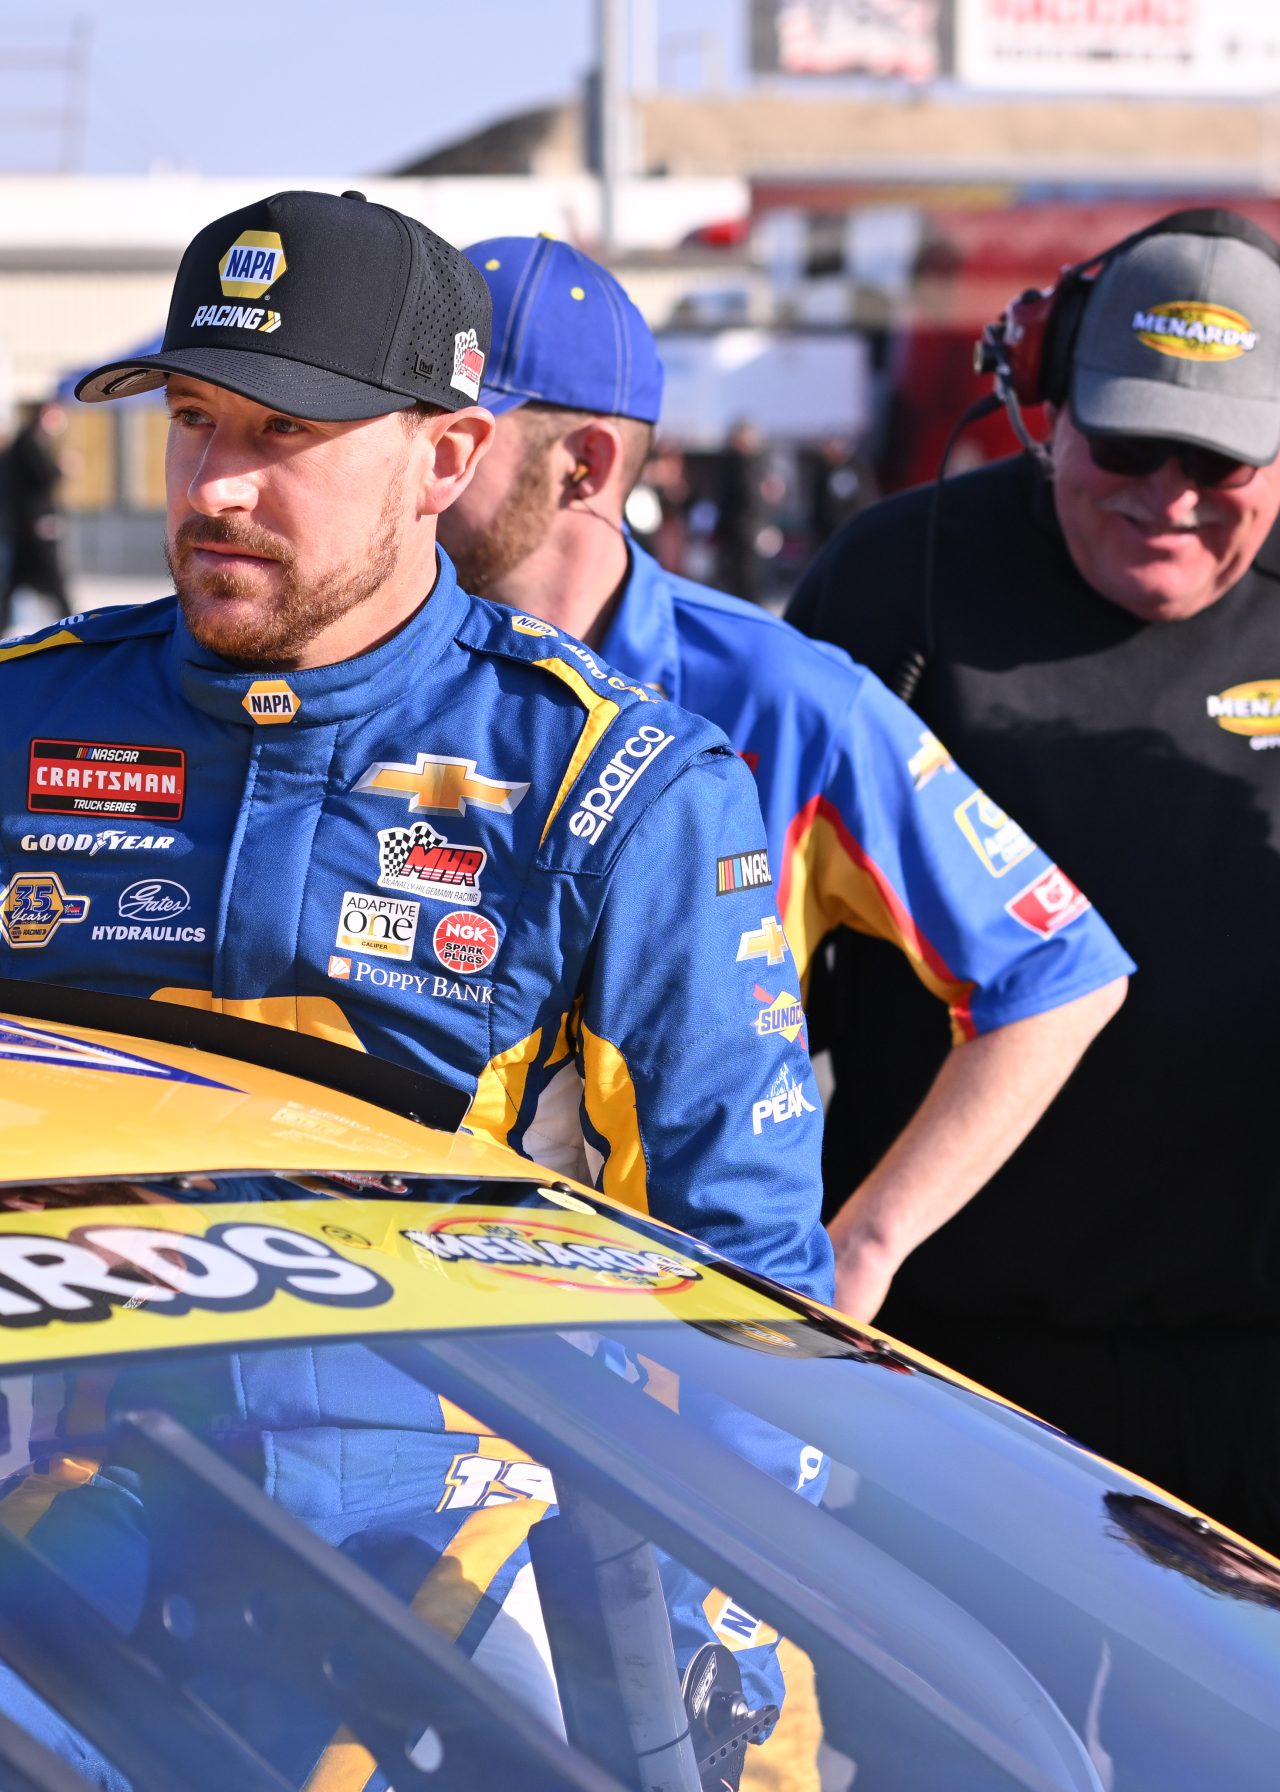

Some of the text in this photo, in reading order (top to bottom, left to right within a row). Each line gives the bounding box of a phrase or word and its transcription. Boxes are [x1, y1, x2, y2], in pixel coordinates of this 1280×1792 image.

[225, 249, 276, 281] NAPA
[191, 305, 265, 329] RACING
[1131, 310, 1258, 350] MENARDS
[251, 694, 292, 713] NAPA
[91, 748, 139, 763] NASCAR
[36, 766, 176, 794] CRAFTSMAN
[569, 725, 668, 845] sparco
[73, 799, 137, 813] TRUCK SERIES
[21, 832, 175, 853] GOODYEAR
[401, 845, 483, 886] MHR
[13, 885, 54, 912] 35
[122, 884, 181, 915] Gates
[346, 896, 417, 917] ADAPTIVE
[453, 891, 479, 903] RACING
[9, 907, 51, 929] Years
[343, 910, 413, 941] one
[91, 926, 206, 942] HYDRAULICS
[445, 923, 487, 943] NGK
[361, 941, 388, 950] CALIPER
[444, 942, 483, 956] SPARK
[443, 951, 483, 965] PLUGS
[354, 961, 497, 1005] POPPY BANK
[752, 1081, 817, 1135] PEAK
[400, 1230, 704, 1281] MENARDS
